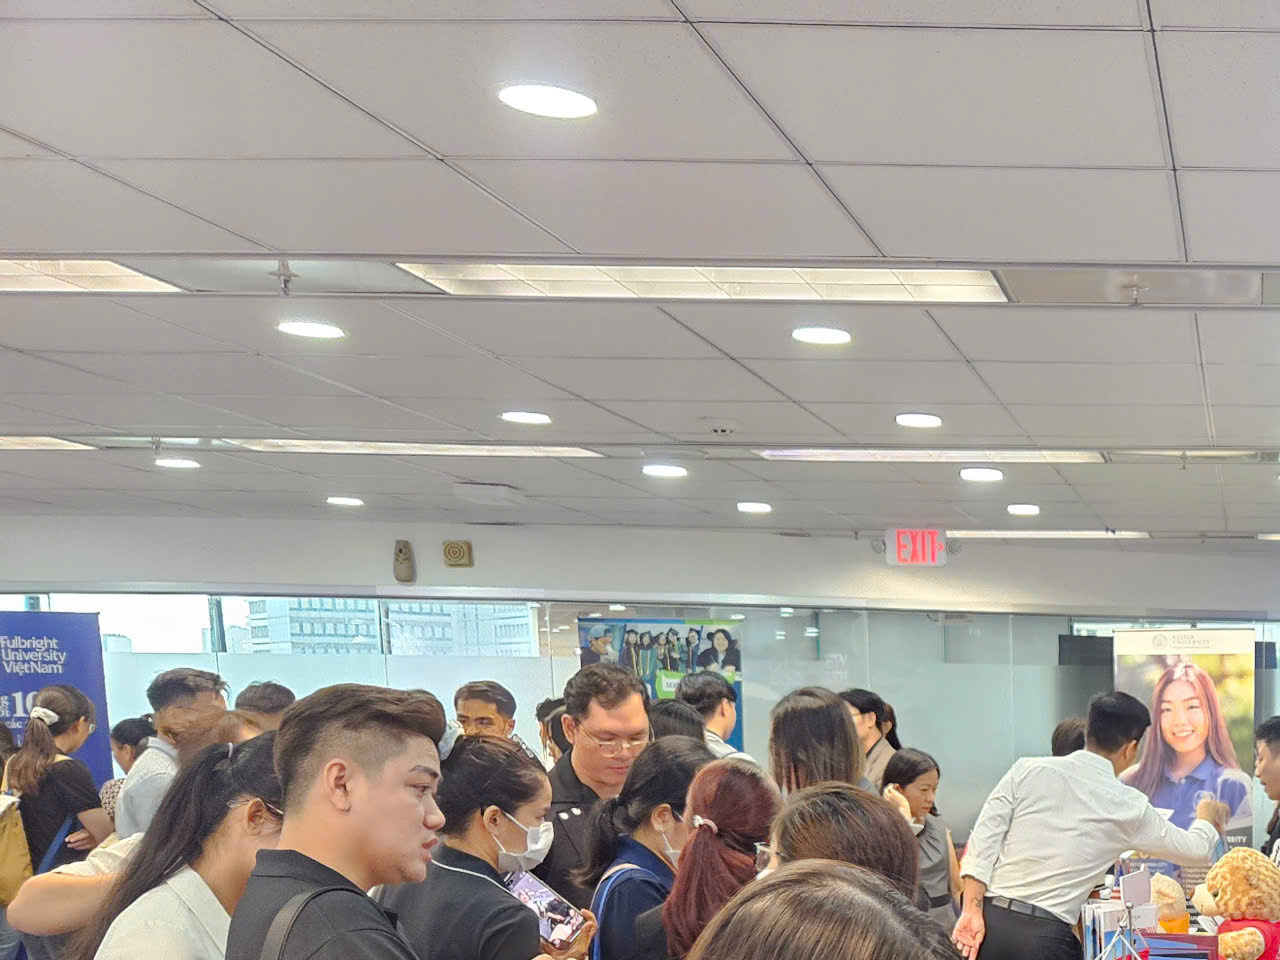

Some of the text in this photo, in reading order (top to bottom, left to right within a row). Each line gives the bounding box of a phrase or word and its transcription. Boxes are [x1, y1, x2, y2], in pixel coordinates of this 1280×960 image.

[896, 528, 938, 565] EXIT
[0, 635, 58, 651] Fulbright
[1, 649, 66, 664] University
